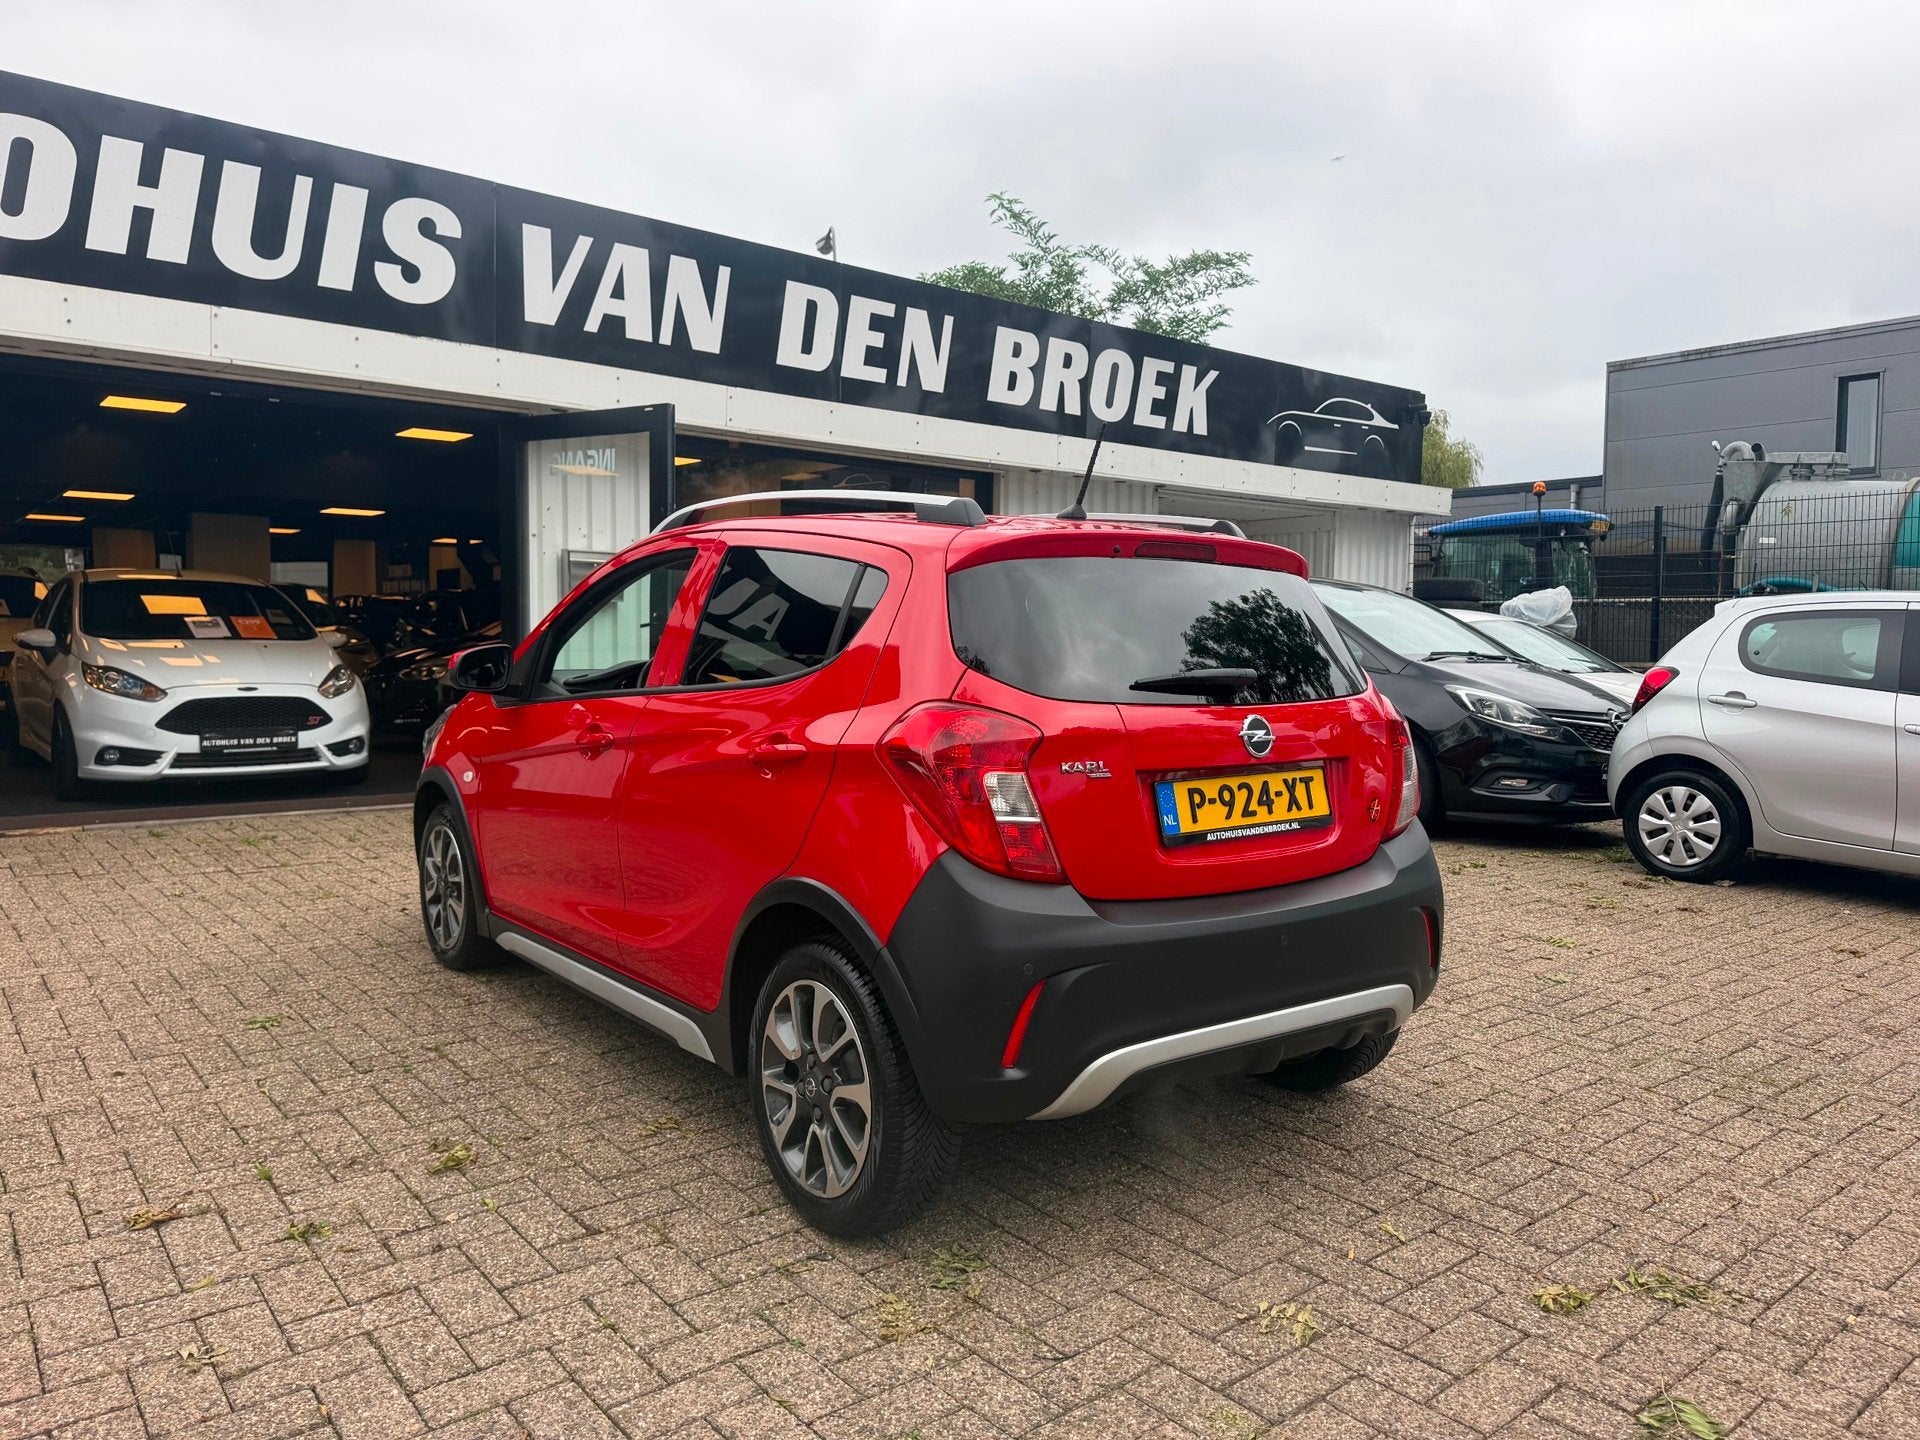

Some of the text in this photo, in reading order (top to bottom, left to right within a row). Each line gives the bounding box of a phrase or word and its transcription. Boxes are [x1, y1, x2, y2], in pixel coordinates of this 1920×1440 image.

[522, 222, 732, 355] VAN
[776, 280, 955, 394] DEN
[987, 325, 1220, 436] BROEK
[202, 738, 238, 747] AUTOHUIS
[256, 737, 271, 745] DEN
[1061, 761, 1110, 774] KARL
[1187, 776, 1315, 824] P-924-XT
[1163, 814, 1178, 827] NL
[1206, 821, 1301, 841] AUTOHUISVANDENBROEK.NL
